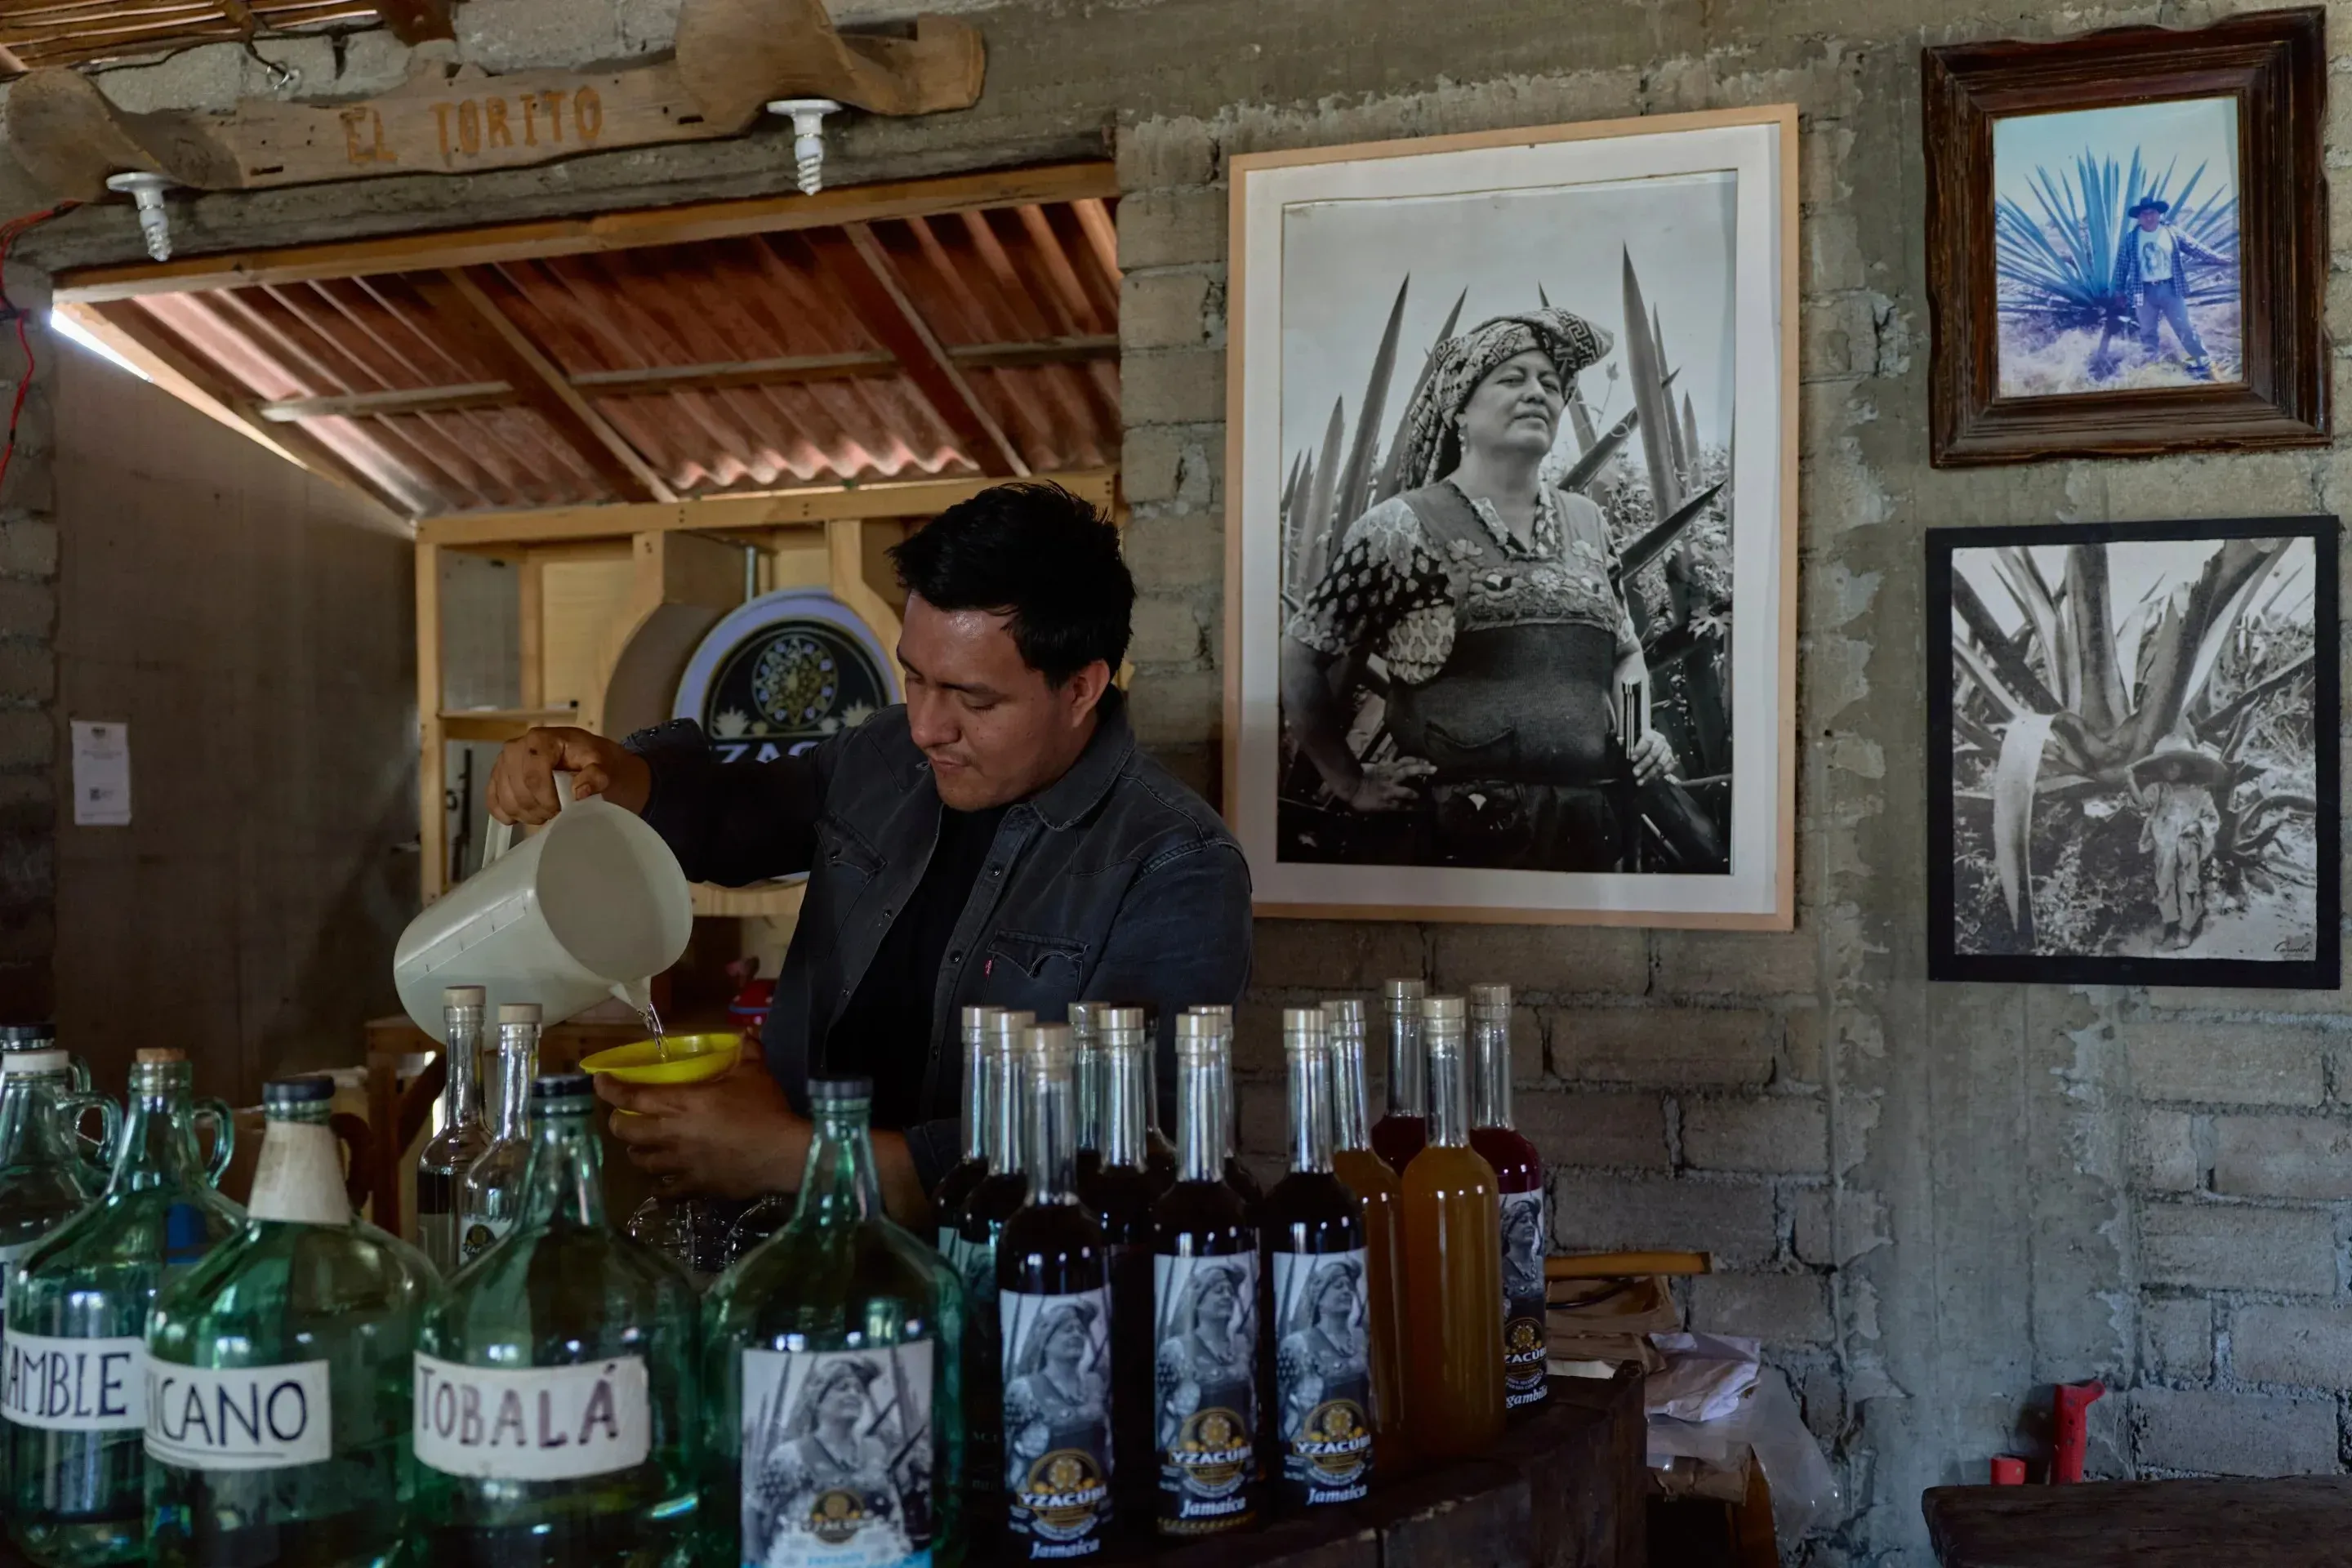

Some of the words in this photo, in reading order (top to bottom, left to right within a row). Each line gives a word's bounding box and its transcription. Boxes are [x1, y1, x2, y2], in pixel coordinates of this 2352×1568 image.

[339, 106, 398, 163] EL
[430, 86, 603, 166] TORITO
[5, 1344, 131, 1419] AMBLE
[420, 1363, 619, 1447] TOBALÁ
